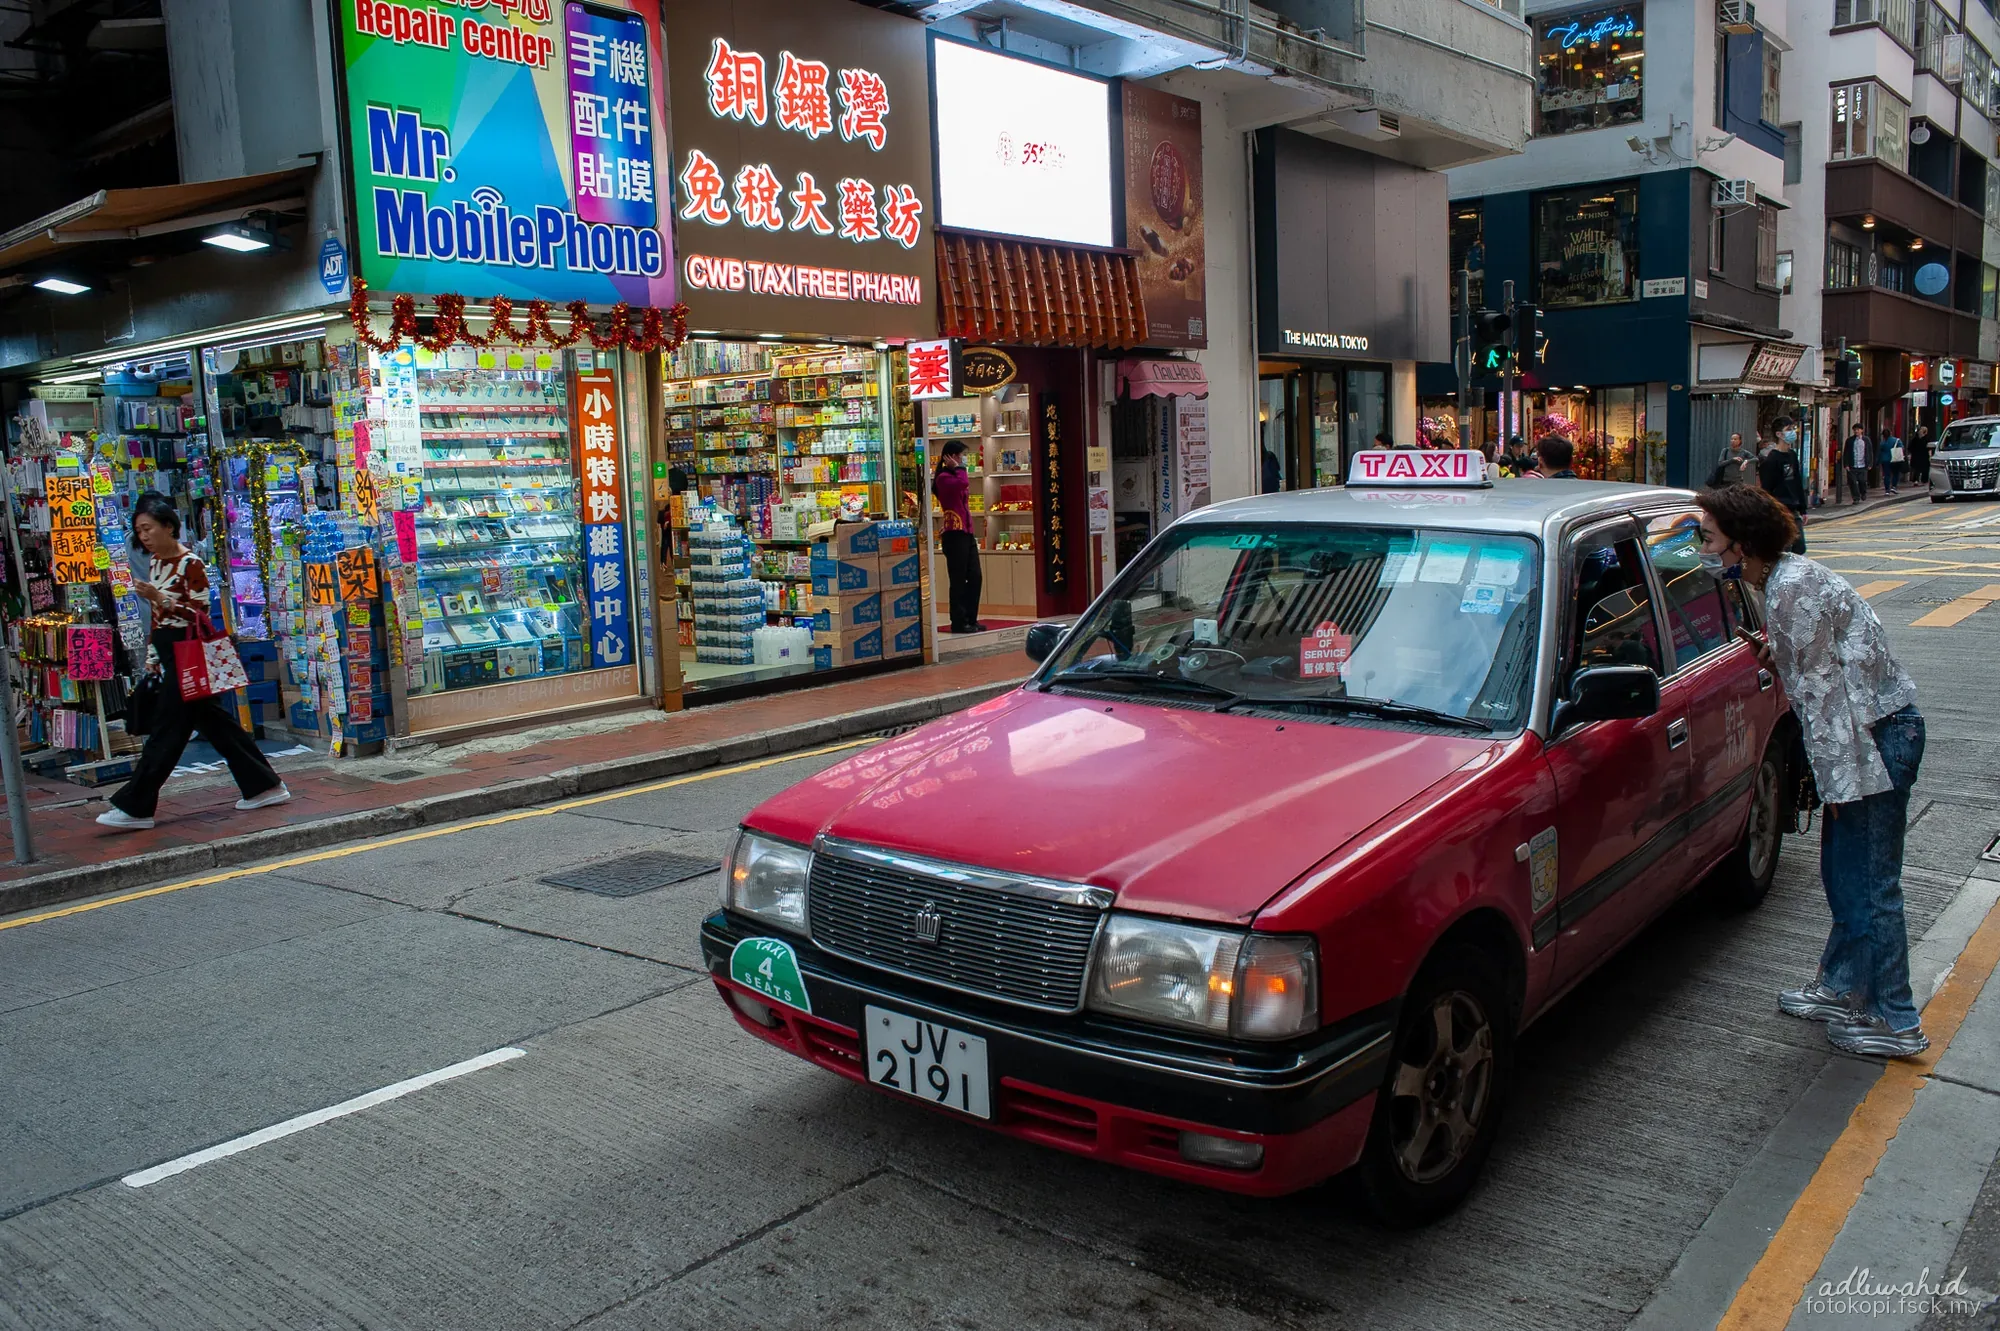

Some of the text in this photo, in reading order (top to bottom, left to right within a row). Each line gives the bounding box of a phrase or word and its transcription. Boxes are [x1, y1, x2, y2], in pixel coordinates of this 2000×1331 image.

[356, 0, 456, 49] Repair
[569, 30, 646, 88] 手機
[705, 38, 889, 151] 銅鑼灣
[573, 90, 649, 145] 配件
[366, 104, 456, 183] Mr.
[578, 152, 653, 203] 貼膜
[1566, 211, 1609, 221] CLOTHING
[1570, 228, 1606, 245] WHITE
[1563, 241, 1597, 260] WHALE
[323, 254, 343, 277] ADT
[685, 254, 921, 305] CWB TAX FREE PHARM
[1302, 332, 1339, 348] MATCHA
[1340, 335, 1368, 351] TOKYO
[1161, 406, 1169, 453] Wellness
[1360, 454, 1468, 477] TAXI
[1162, 477, 1170, 499] One
[50, 506, 95, 528] Macau
[1316, 628, 1336, 639] OUT
[1319, 639, 1332, 648] OF
[1304, 648, 1346, 660] SERVICE
[507, 681, 564, 704] REPAIR
[572, 668, 632, 693] CENTRE
[756, 940, 786, 959] TAXI
[758, 957, 773, 980] 4
[745, 972, 792, 1002] SEATS
[901, 1020, 949, 1065] JV
[877, 1049, 969, 1111] 2191
